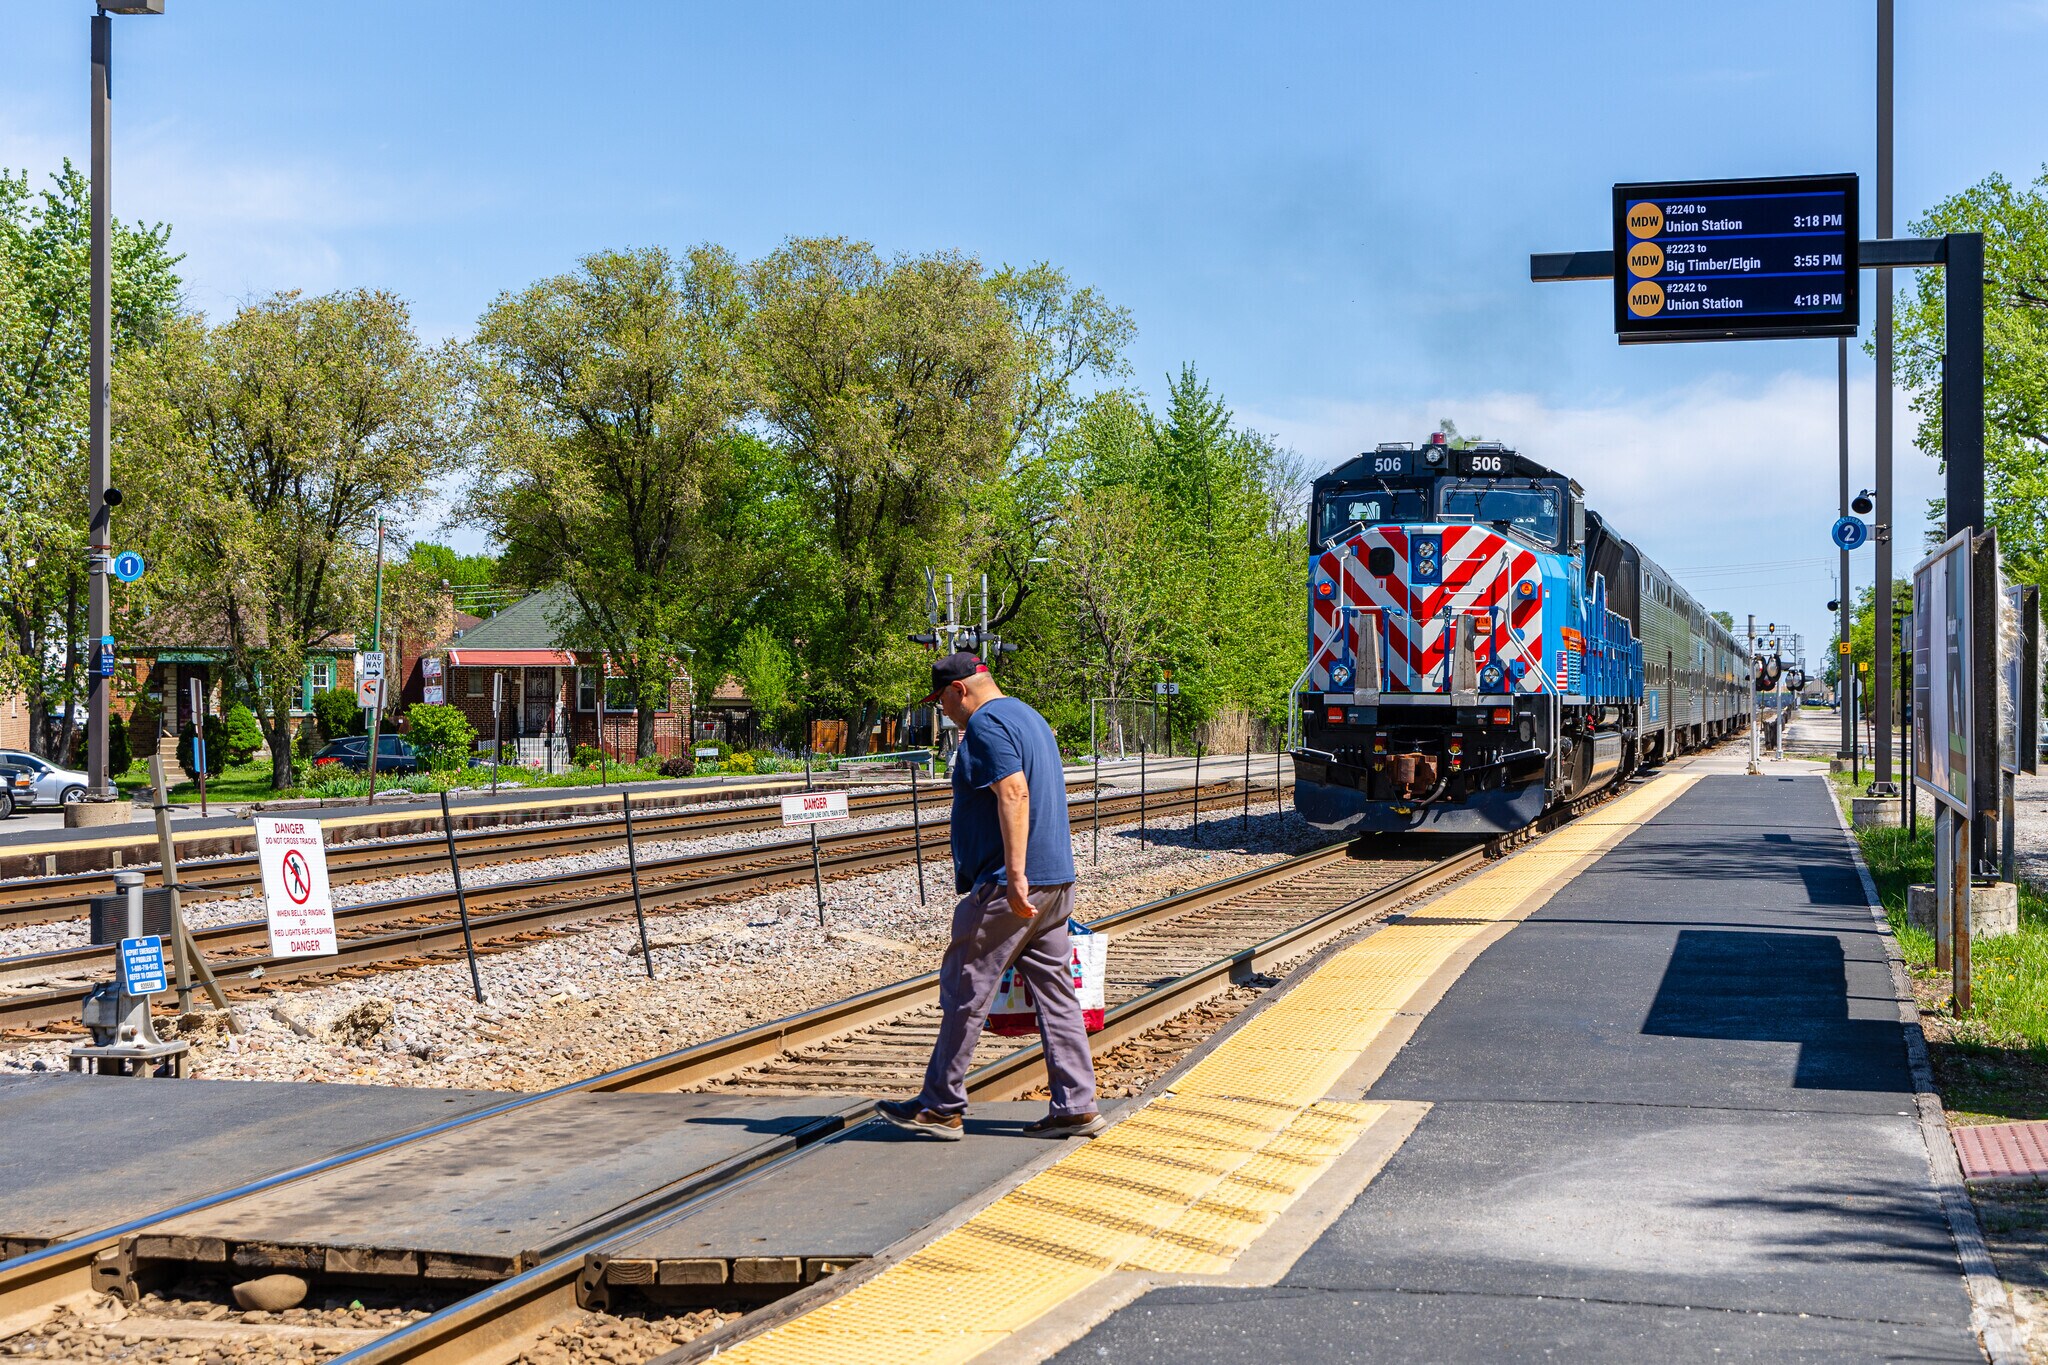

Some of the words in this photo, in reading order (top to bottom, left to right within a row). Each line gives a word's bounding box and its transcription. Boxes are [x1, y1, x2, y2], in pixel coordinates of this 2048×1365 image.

[1666, 204, 1694, 214] #2240
[1697, 204, 1706, 214] to
[1631, 216, 1659, 227] MDW
[1666, 220, 1698, 232] Union
[1702, 219, 1742, 231] Station
[1793, 216, 1820, 228] 3:18
[1823, 214, 1842, 226] PM
[1666, 244, 1695, 254] #2223
[1697, 244, 1706, 253] to
[1632, 256, 1659, 266] MDW
[1666, 260, 1685, 274] Big
[1688, 257, 1761, 271] Timber/Elgin
[1794, 255, 1820, 267] 3:55
[1823, 254, 1842, 266] PM
[1666, 283, 1695, 293] #2242
[1698, 283, 1707, 292] to
[1632, 295, 1660, 305] MDW
[1667, 299, 1699, 310] Union
[1702, 297, 1743, 309] Station
[1794, 295, 1820, 306] 4:18
[1823, 294, 1842, 305] PM
[1374, 457, 1402, 472] 506
[1472, 456, 1501, 471] 506
[1844, 524, 1855, 542] 2
[125, 559, 132, 574] 1
[1842, 643, 1849, 653] 5
[804, 797, 828, 810] DANGER
[274, 823, 305, 834] DANGER
[290, 940, 321, 952] DANGER
